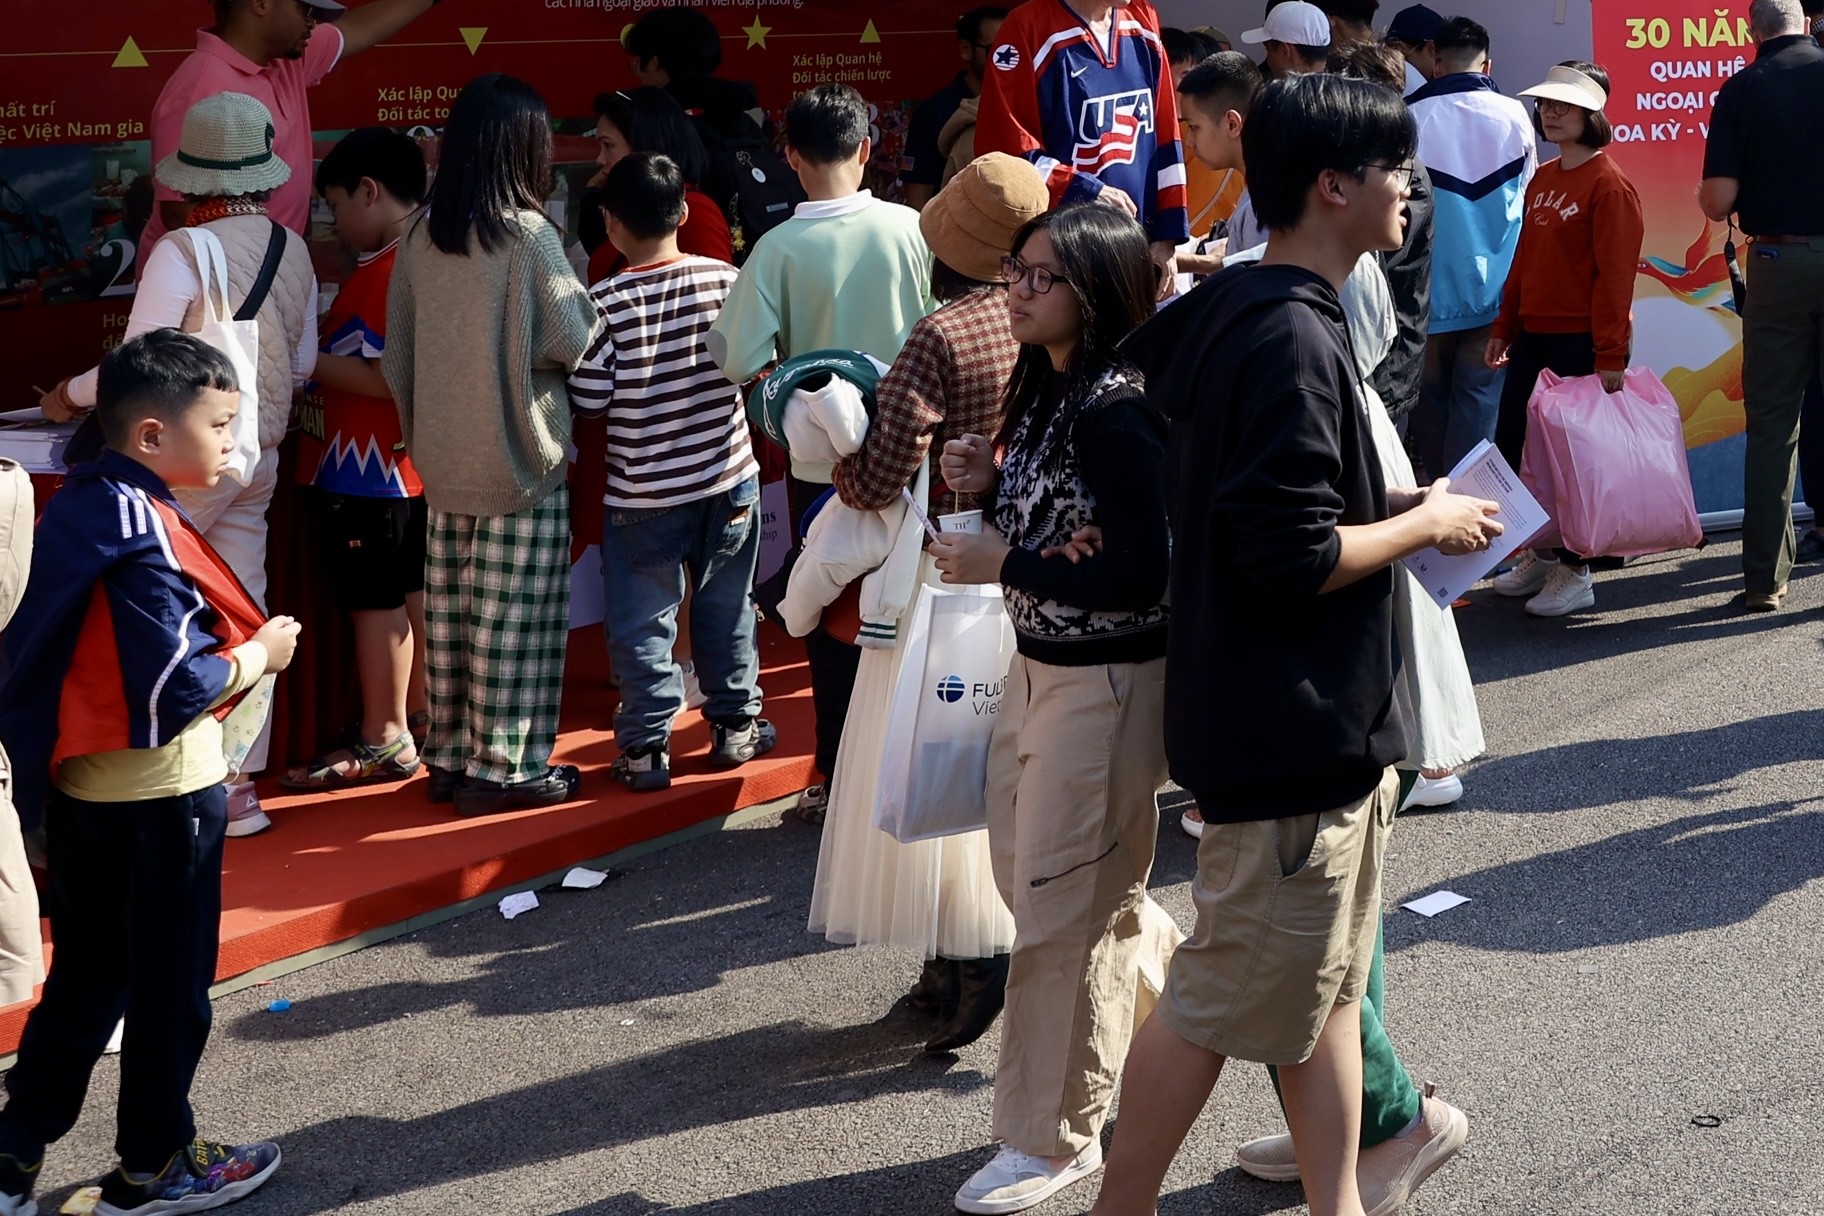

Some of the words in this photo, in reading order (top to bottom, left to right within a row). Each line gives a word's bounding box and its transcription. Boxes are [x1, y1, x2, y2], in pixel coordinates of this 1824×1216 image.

[1625, 17, 1670, 48] 30
[793, 55, 812, 66] Xác
[816, 54, 833, 68] lập
[836, 53, 865, 65] Quan
[869, 52, 882, 64] hệ
[793, 71, 811, 83] Đối
[815, 71, 832, 82] tác
[835, 69, 864, 82] chiến
[867, 69, 891, 82] lược
[1650, 61, 1711, 81] QUAN
[378, 87, 405, 101] Xác
[409, 86, 432, 103] lập
[1637, 91, 1703, 114] NGOẠI
[32, 100, 55, 116] trí
[378, 106, 402, 121] Đối
[408, 108, 430, 120] tác
[23, 123, 60, 141] Việt
[67, 122, 111, 137] Nam
[117, 120, 143, 138] gia
[1072, 88, 1154, 176] USA
[1611, 125, 1646, 142] OA
[1651, 119, 1682, 141] KỲ
[1525, 190, 1580, 222] OLAR
